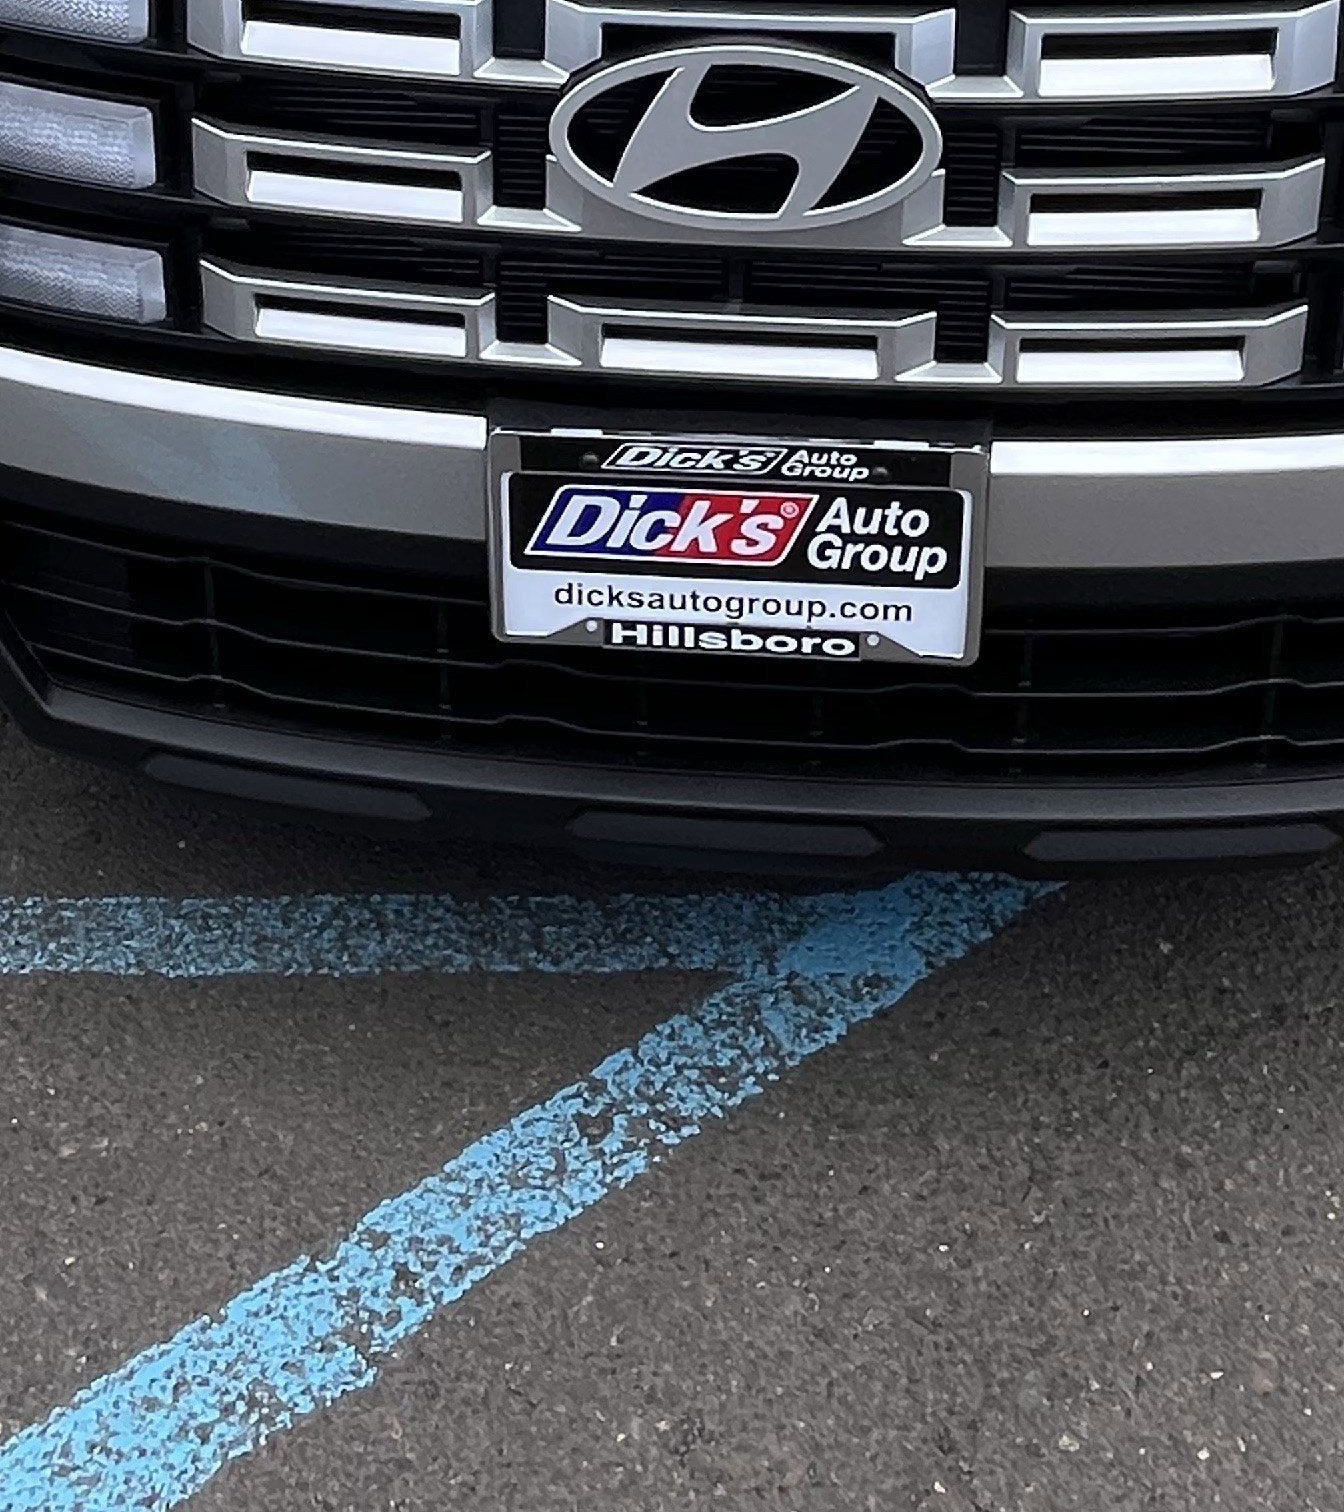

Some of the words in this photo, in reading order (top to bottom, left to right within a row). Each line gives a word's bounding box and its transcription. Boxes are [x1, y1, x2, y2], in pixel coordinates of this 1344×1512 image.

[616, 445, 769, 471] Dick's
[790, 449, 858, 466] Auto
[780, 462, 869, 482] Group
[544, 494, 786, 557] Dick's
[815, 496, 931, 538] Auto
[807, 536, 947, 580] Group
[553, 582, 913, 622] dicksautogroup.com
[610, 622, 856, 655] Hillsboro
